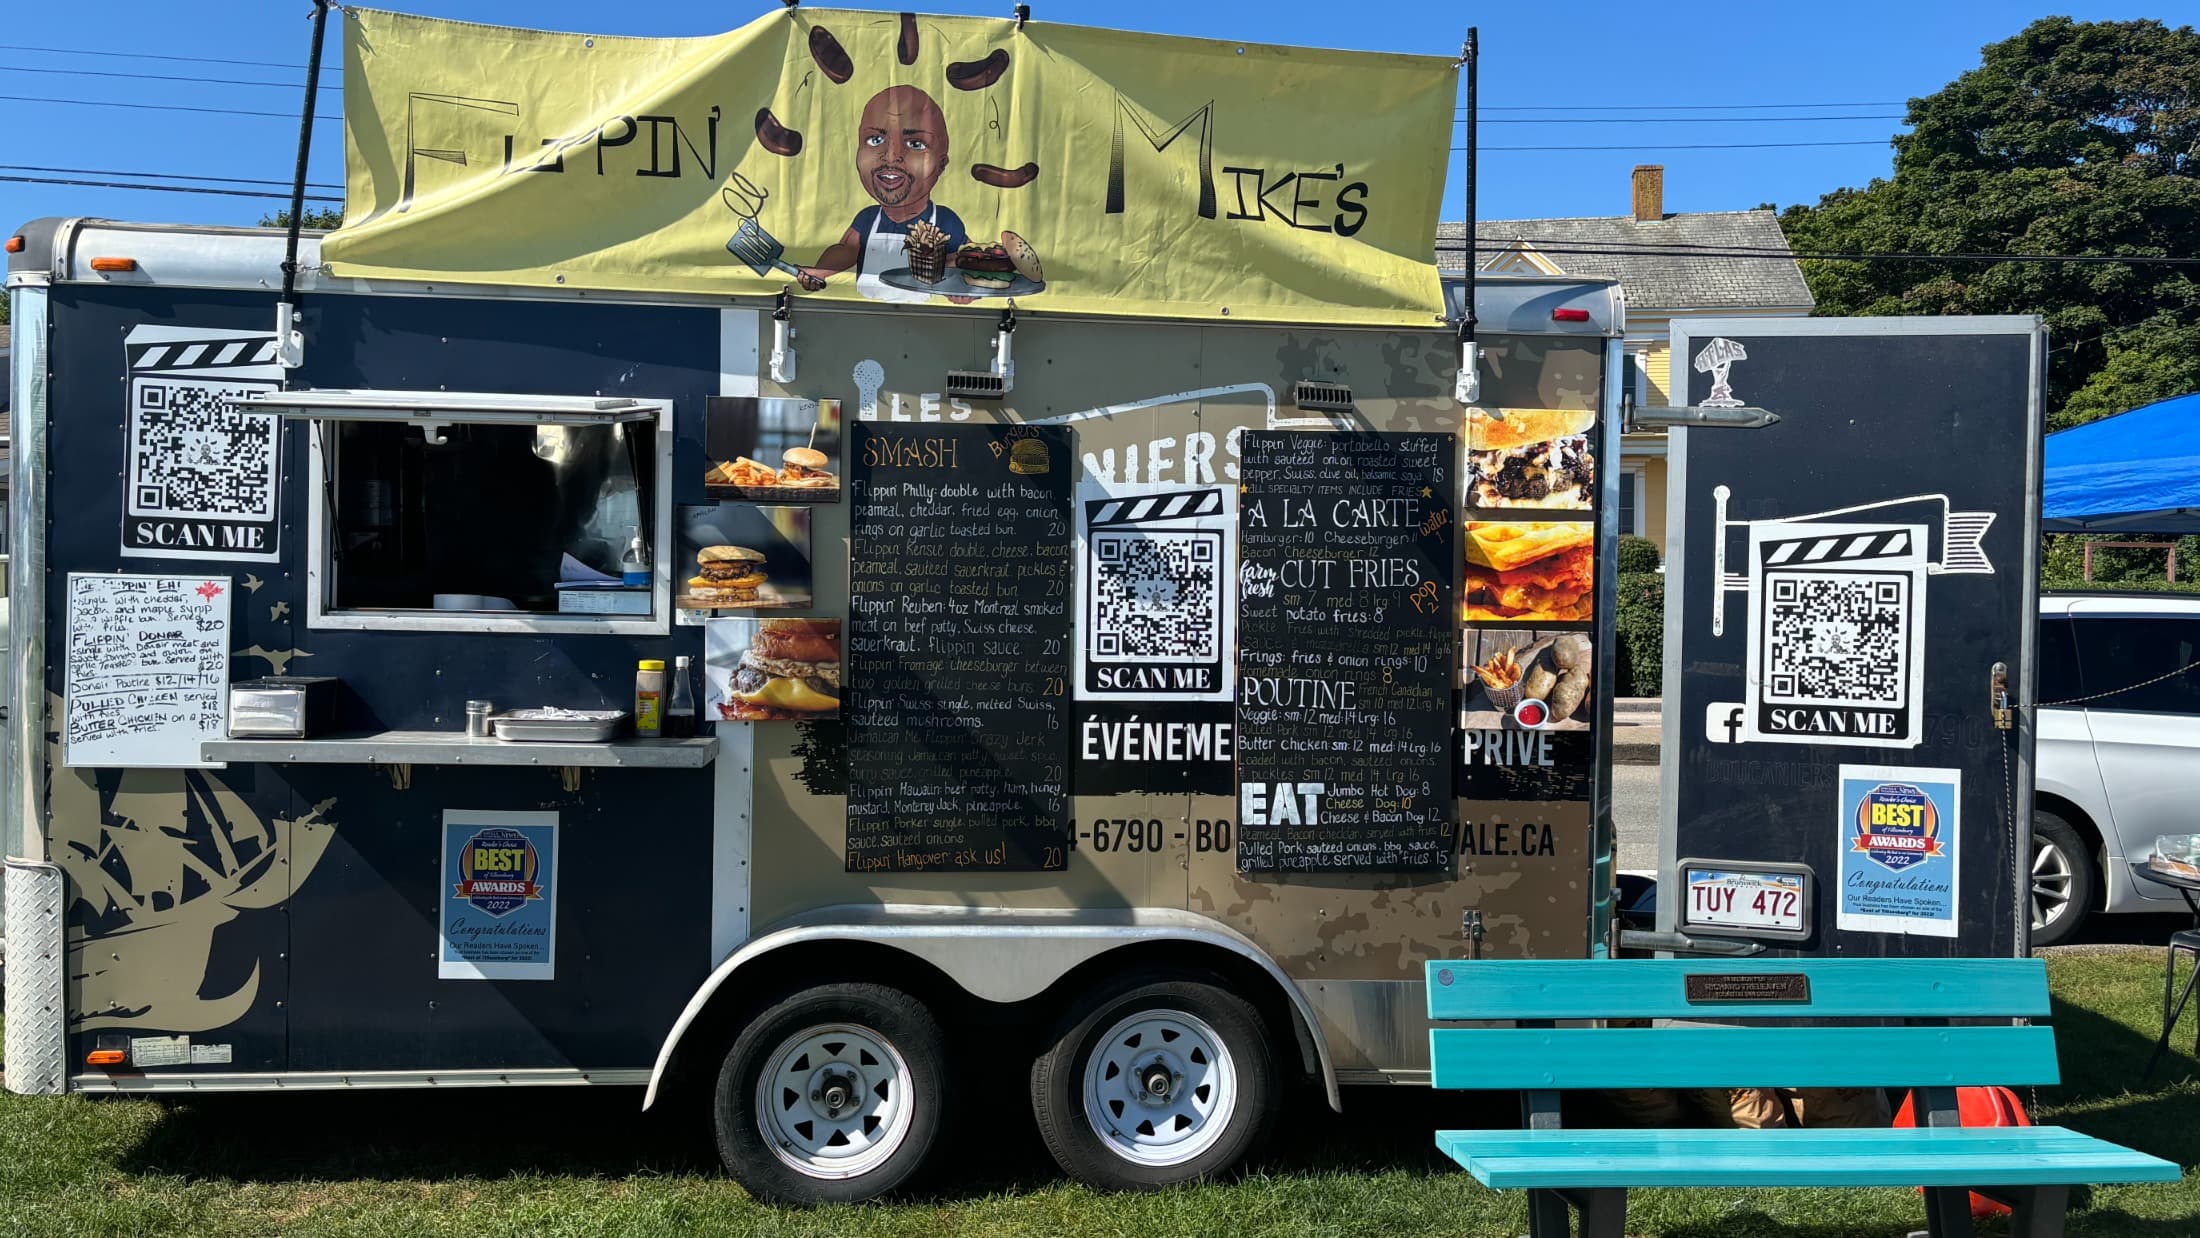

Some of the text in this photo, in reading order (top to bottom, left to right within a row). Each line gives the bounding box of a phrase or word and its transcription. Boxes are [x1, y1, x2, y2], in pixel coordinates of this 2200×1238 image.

[1105, 87, 1369, 237] MIKE'S
[863, 425, 1041, 468] SMASH Burgers
[1332, 437, 1438, 455] portobello stuffed
[1242, 453, 1438, 467] with sauteed onion roasted sweet
[1319, 467, 1444, 483] olive 18
[940, 482, 1015, 499] double with
[1318, 485, 1422, 497] ITEMS INCLUDE FRIES
[962, 504, 1059, 519] fried onion
[1248, 499, 1422, 528] A LA CARTE
[1418, 508, 1448, 537] water
[136, 522, 265, 549] SCAN ME
[855, 522, 1065, 543] rings on garlic toasted 20
[1241, 545, 1380, 561] Bacon Cheeseburger 12
[1240, 559, 1280, 582] farm
[1280, 558, 1420, 589] CUT FRIES
[852, 580, 1064, 597] onions on garlic 20
[1242, 578, 1275, 599] fresh
[141, 606, 174, 614] maple
[180, 605, 213, 614] syrup
[852, 595, 1064, 616] Flippin' 4oz Montreal smoked
[1241, 604, 1384, 624] Sweet potato fries: 8
[1428, 602, 1439, 613] 2
[196, 620, 225, 632] $20
[852, 617, 995, 634] meat on beef Swiss
[139, 631, 185, 642] DONAIR
[172, 640, 197, 648] meat
[1042, 639, 1061, 655] 20
[1240, 648, 1427, 673] Frings: fries & onion 10
[1097, 667, 1211, 689] SCAN ME
[1382, 666, 1392, 684] 8
[1042, 677, 1064, 697] 20
[1242, 676, 1356, 710] POUTINE
[976, 700, 1012, 710] melted
[851, 713, 1059, 730] sauteed mushrooms. 16
[1303, 708, 1396, 725] 12 16
[1770, 709, 1847, 733] SCAN
[1853, 712, 1896, 735] ME
[71, 719, 115, 735] BUTTER
[71, 733, 102, 744] served
[1239, 736, 1441, 753] Butter 12 14 16
[1327, 781, 1431, 798] Jumbo Hot 8
[1048, 798, 1061, 812] 16
[1241, 782, 1325, 826] EAT
[1326, 797, 1411, 809] Cheese 10
[1320, 808, 1441, 824] Cheese & Bacon 12
[1872, 804, 1923, 826] BEST
[1440, 822, 1451, 837] 12
[1239, 841, 1344, 855] Pulled sauteed
[1869, 837, 1925, 848] AWARDS
[474, 849, 524, 871] BEST
[898, 840, 1062, 870] Hangover ask us! 20
[1241, 851, 1448, 872] grilled pineapple served with 15
[1885, 856, 1909, 864] 2022
[471, 882, 525, 892] AWARDS
[1848, 871, 1949, 894] Congratulations
[487, 901, 510, 909] 2022
[1693, 886, 1796, 916] TUY 472
[450, 917, 546, 940] Congratulations
